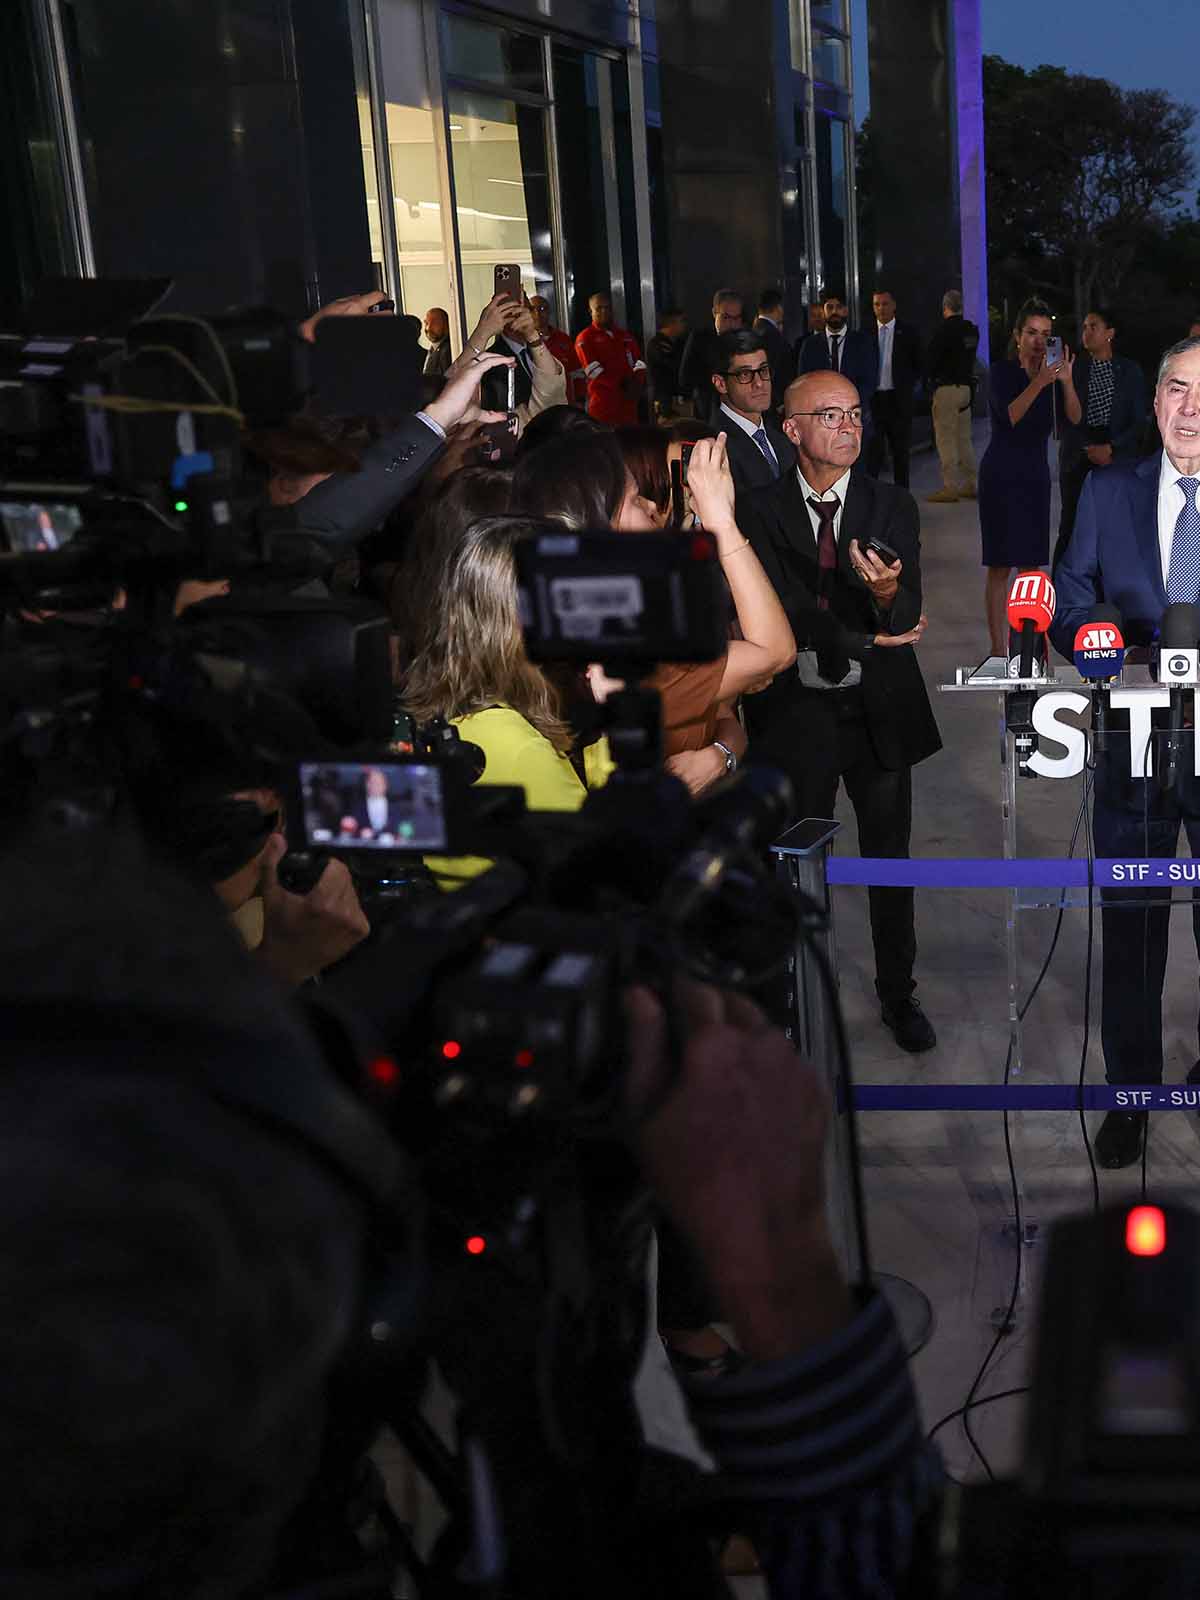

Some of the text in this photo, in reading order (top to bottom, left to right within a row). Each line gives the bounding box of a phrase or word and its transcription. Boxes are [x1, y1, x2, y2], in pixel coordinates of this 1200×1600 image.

[1084, 650, 1117, 660] NEWS
[1112, 864, 1150, 881] STF
[1116, 1091, 1152, 1105] STF
